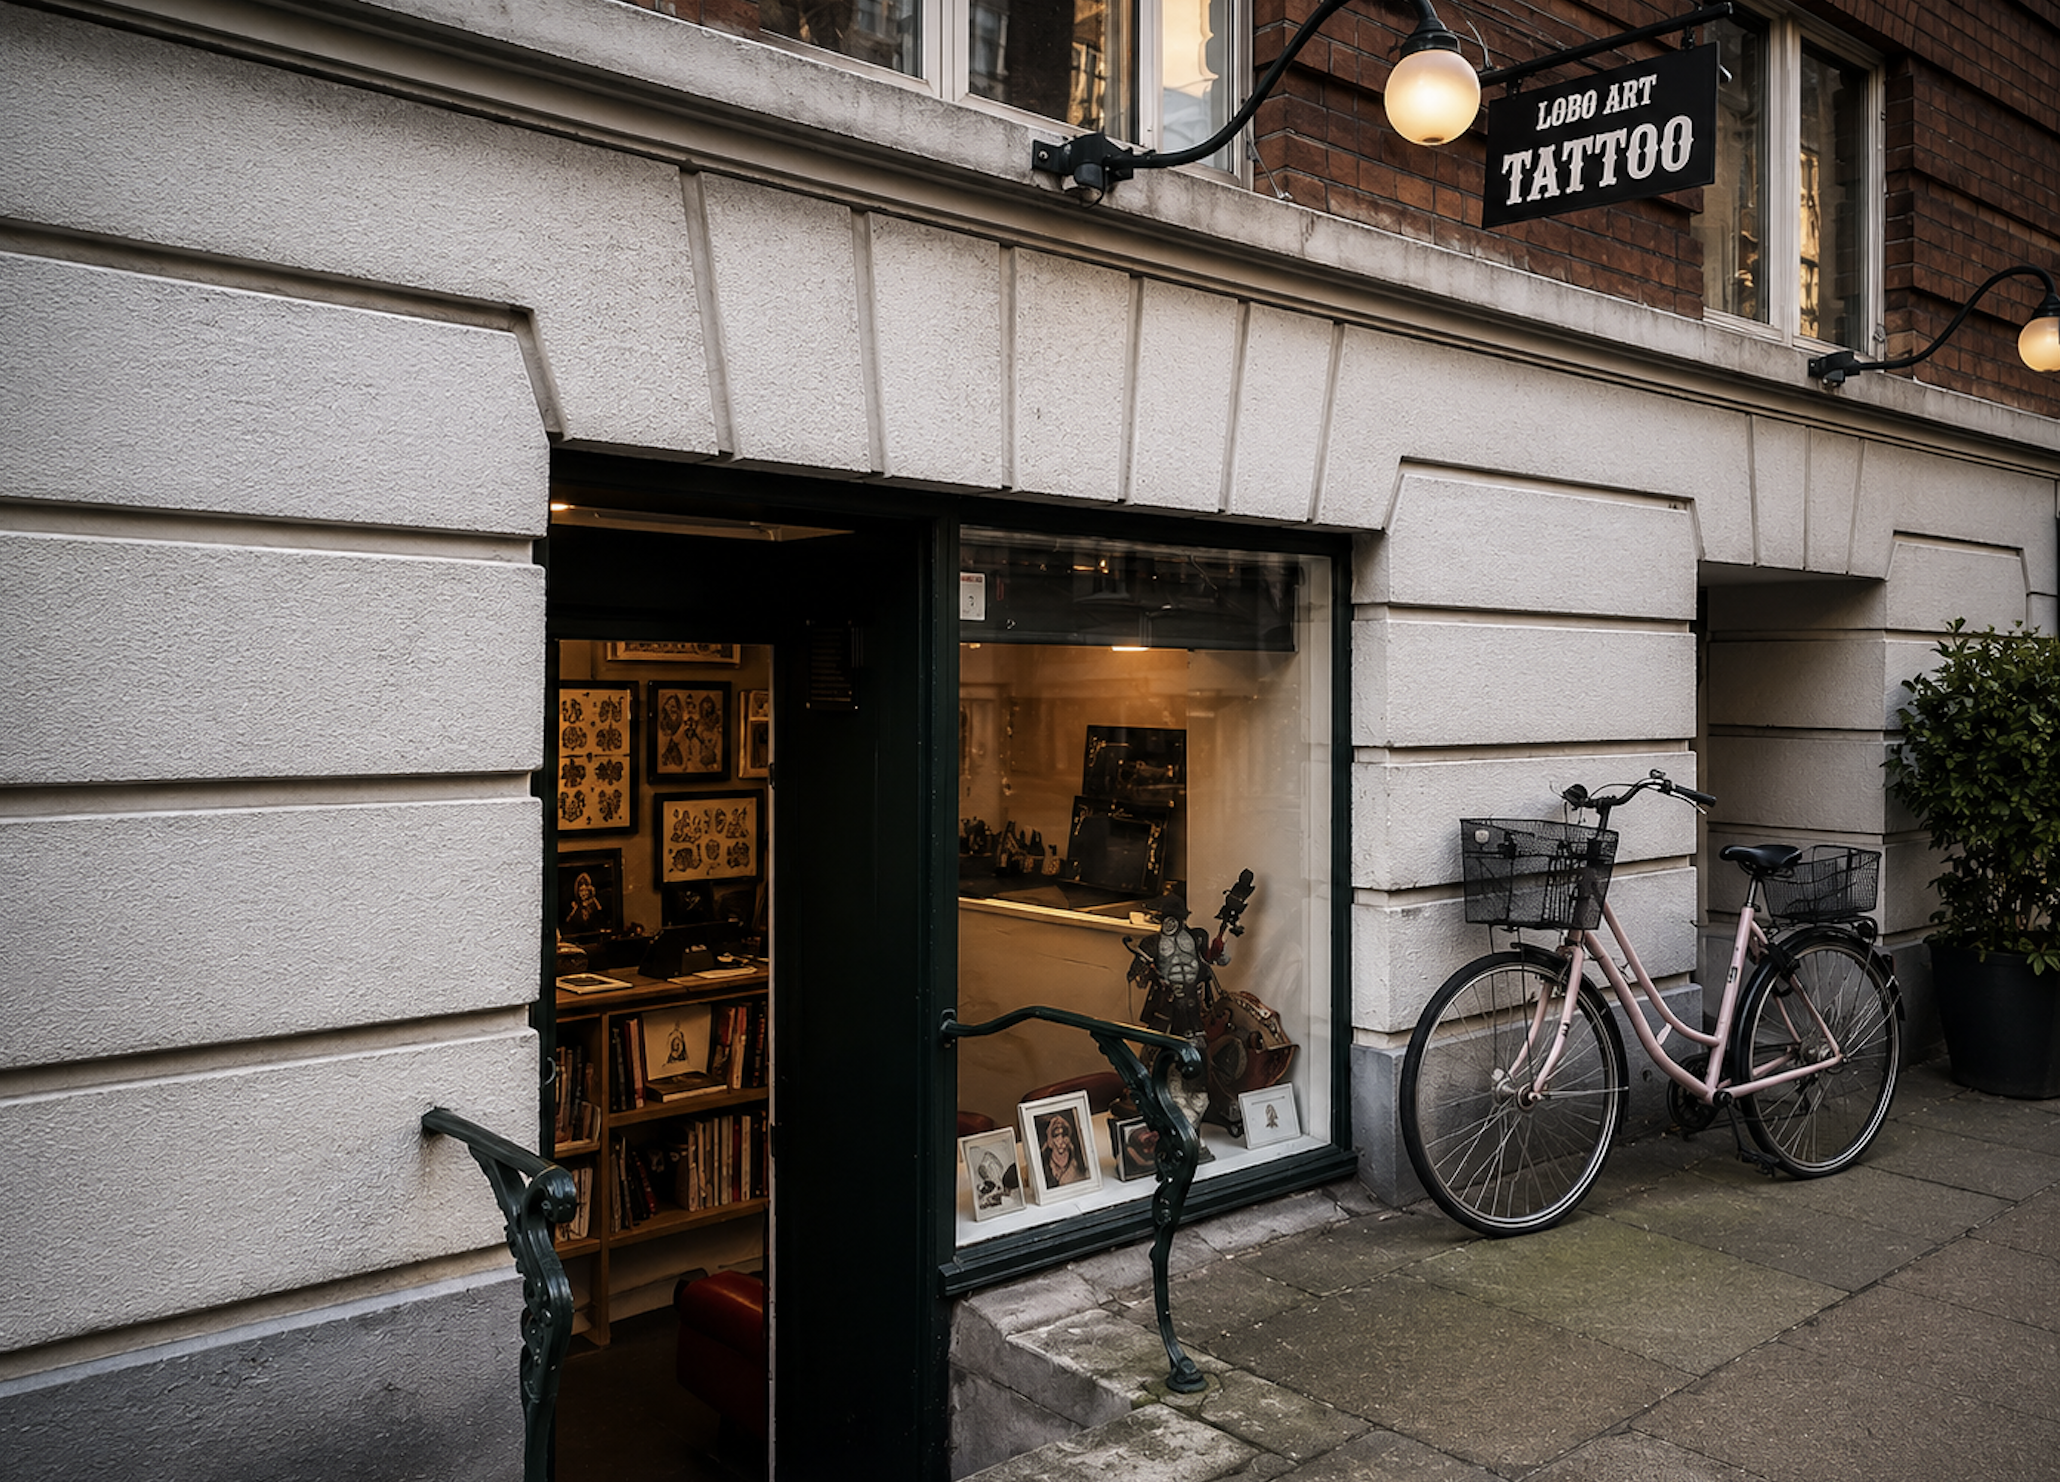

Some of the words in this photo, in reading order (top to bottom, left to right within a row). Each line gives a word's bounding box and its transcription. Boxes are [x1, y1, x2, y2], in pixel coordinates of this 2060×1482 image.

[1535, 88, 1598, 131] LOBO
[1602, 73, 1658, 115] ART
[1501, 114, 1695, 206] TATTOO
